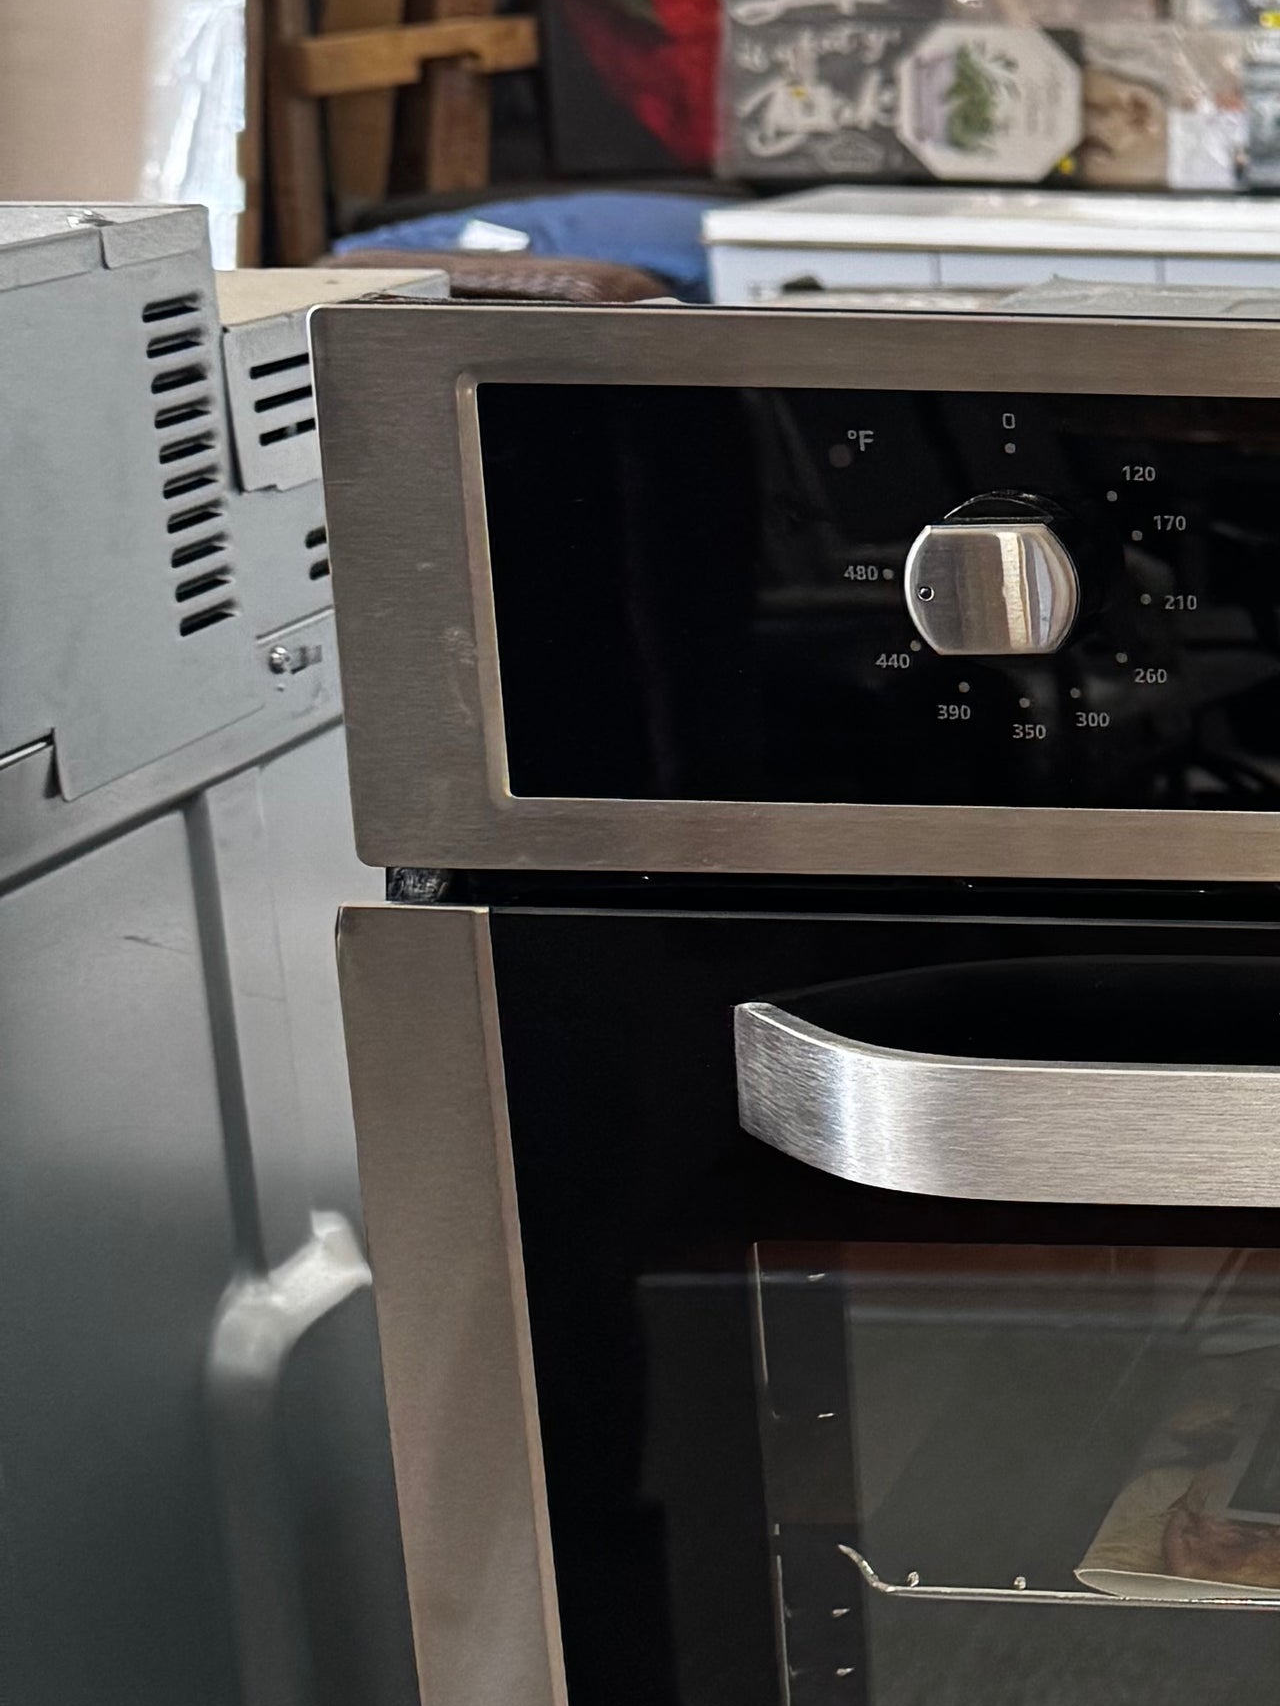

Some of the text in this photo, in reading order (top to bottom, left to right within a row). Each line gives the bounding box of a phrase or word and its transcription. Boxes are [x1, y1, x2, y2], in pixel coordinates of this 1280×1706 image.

[1122, 465, 1156, 482] 120
[1153, 514, 1187, 531] 170
[843, 565, 879, 581] 480
[1164, 594, 1198, 611] 210
[875, 652, 910, 669] 440
[1134, 668, 1168, 684] 260
[937, 704, 971, 720] 390
[1075, 711, 1110, 728] 300
[1012, 723, 1047, 740] 350
